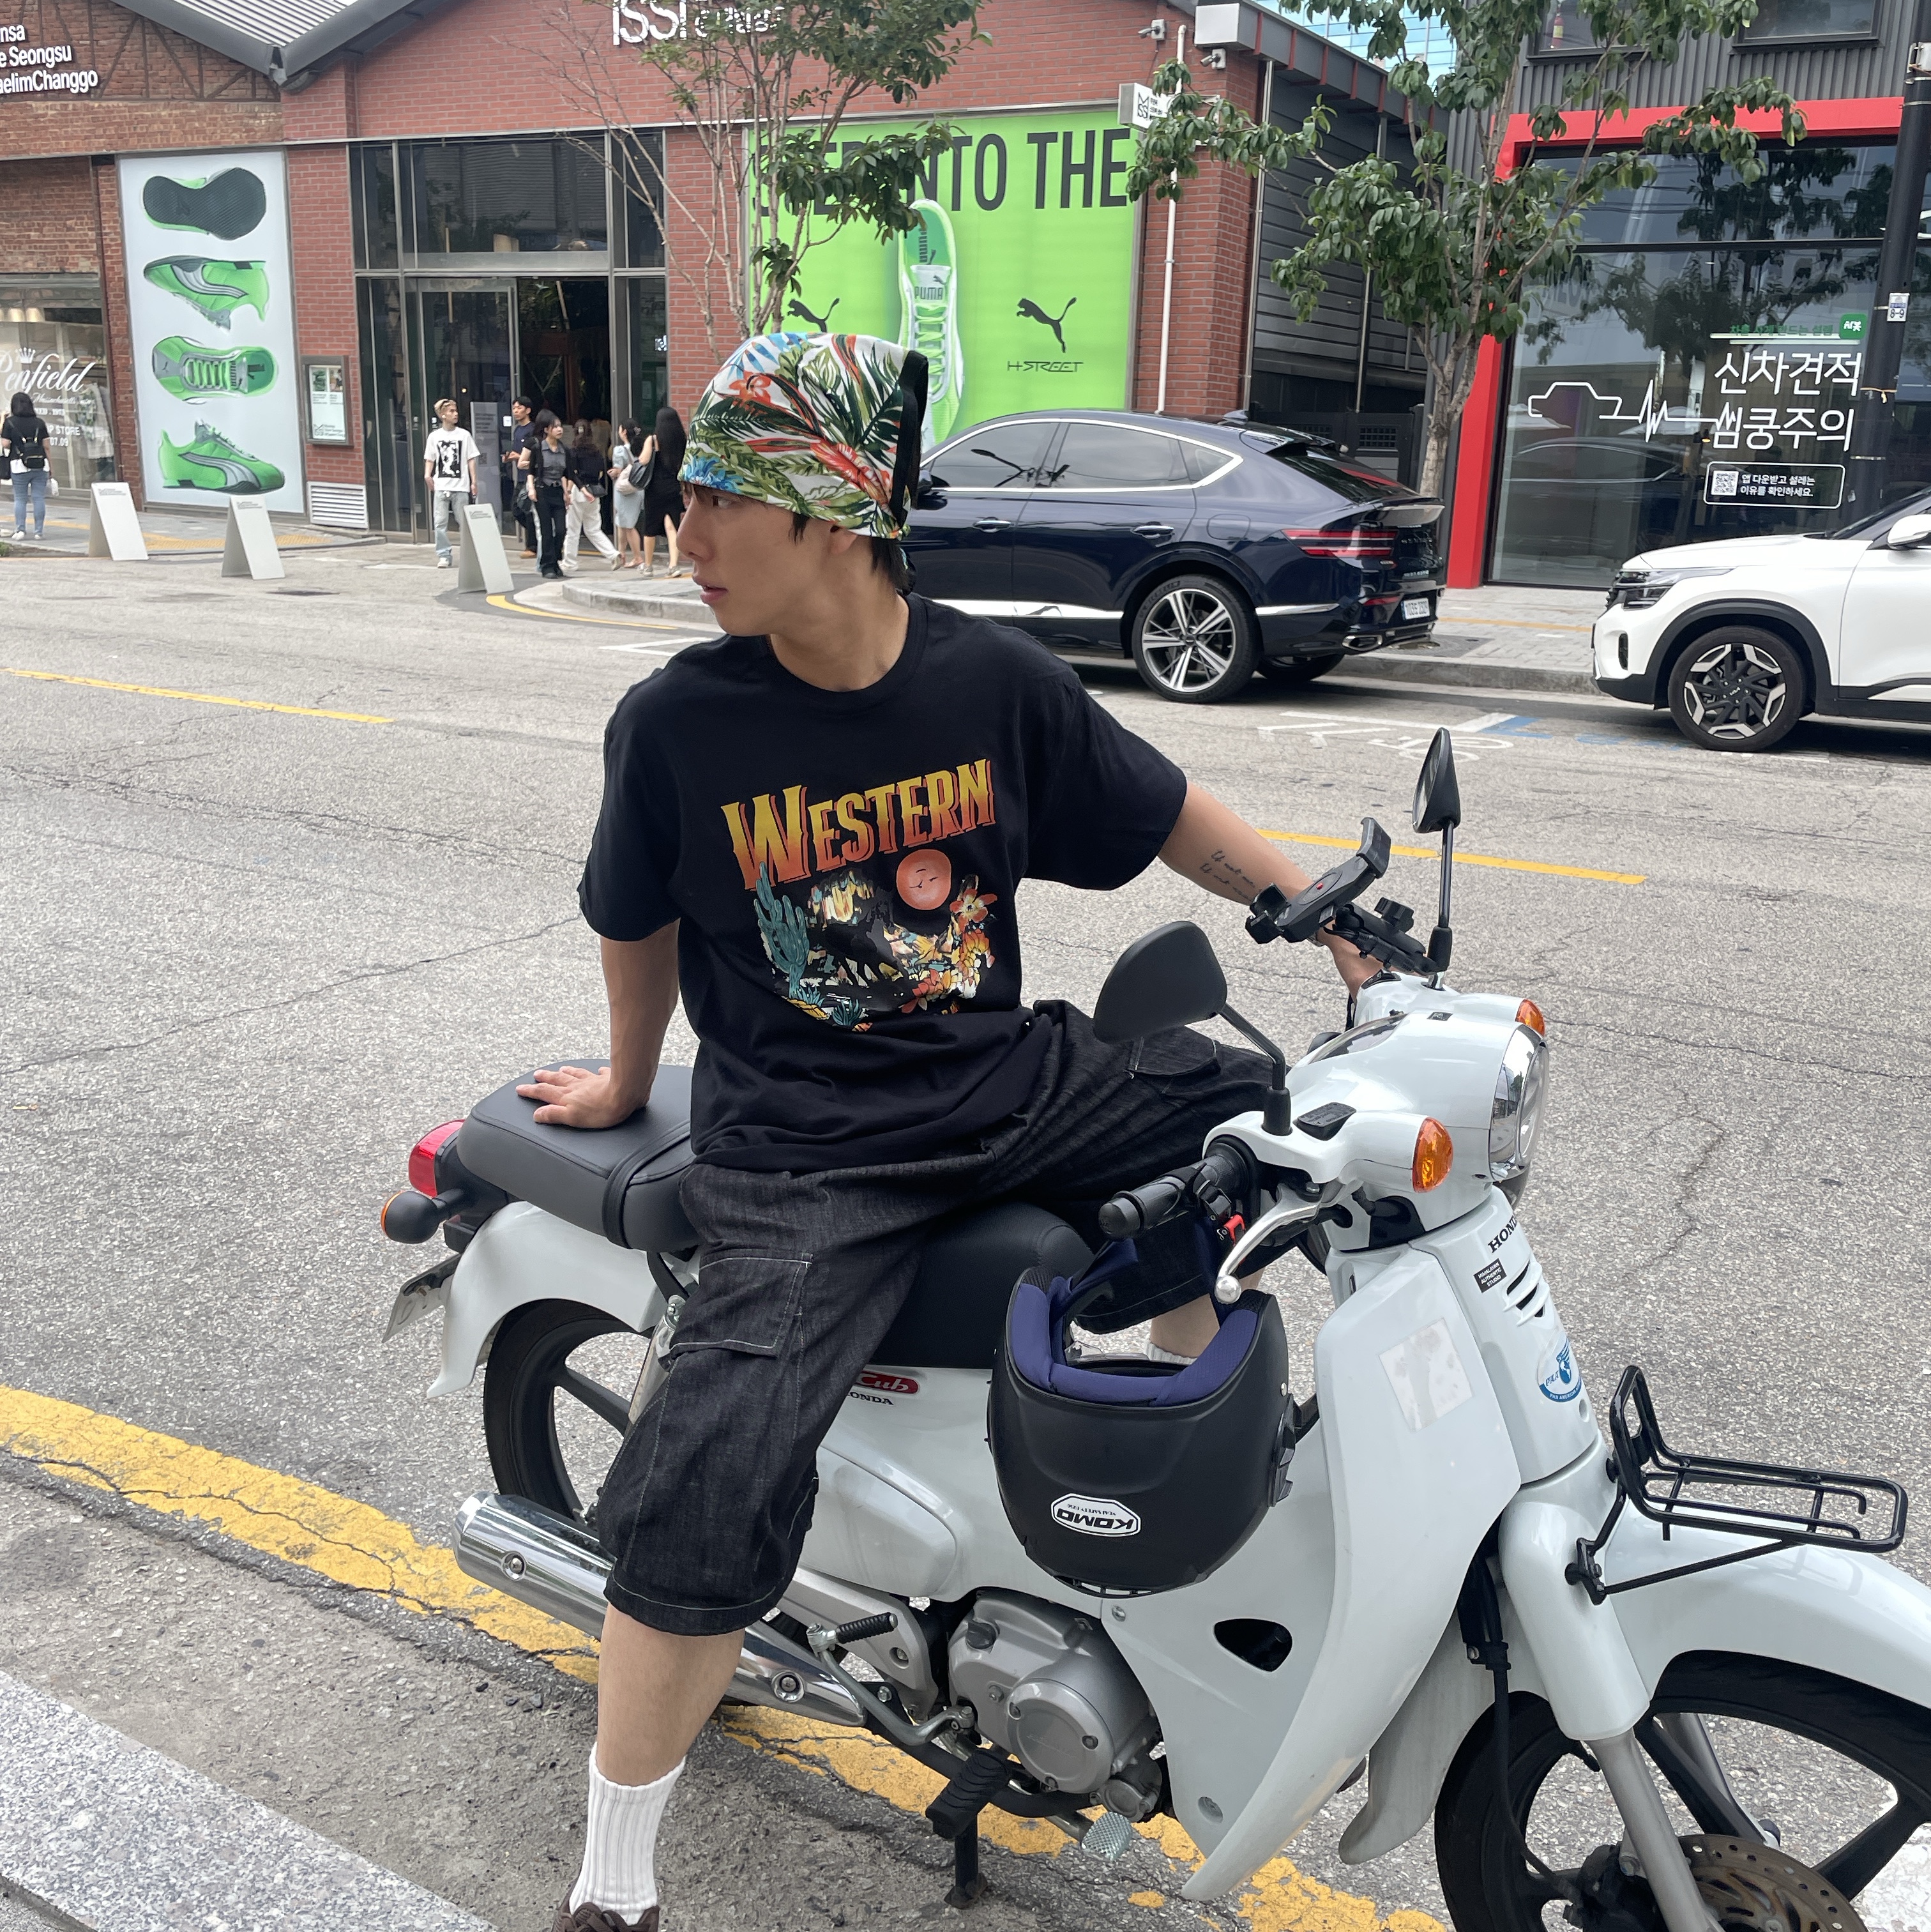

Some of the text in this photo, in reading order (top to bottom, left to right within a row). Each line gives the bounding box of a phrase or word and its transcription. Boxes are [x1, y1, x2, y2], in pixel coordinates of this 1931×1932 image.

[9, 45, 72, 68] Seongsu
[891, 133, 1007, 212] NTO
[1027, 128, 1130, 209] THE
[914, 286, 943, 300] PUMA
[1890, 308, 1904, 319] 8-9
[1715, 351, 1862, 397] 신차견적
[56, 425, 80, 436] STORE
[1752, 474, 1787, 485] 다운받고
[1789, 475, 1815, 486] 설레는
[721, 758, 996, 892] WESTERN
[1481, 1266, 1502, 1284] AUTHENTIC
[1487, 1274, 1501, 1287] STUDIO
[847, 1392, 894, 1406] ONDA
[1056, 1508, 1134, 1530] KOMO
